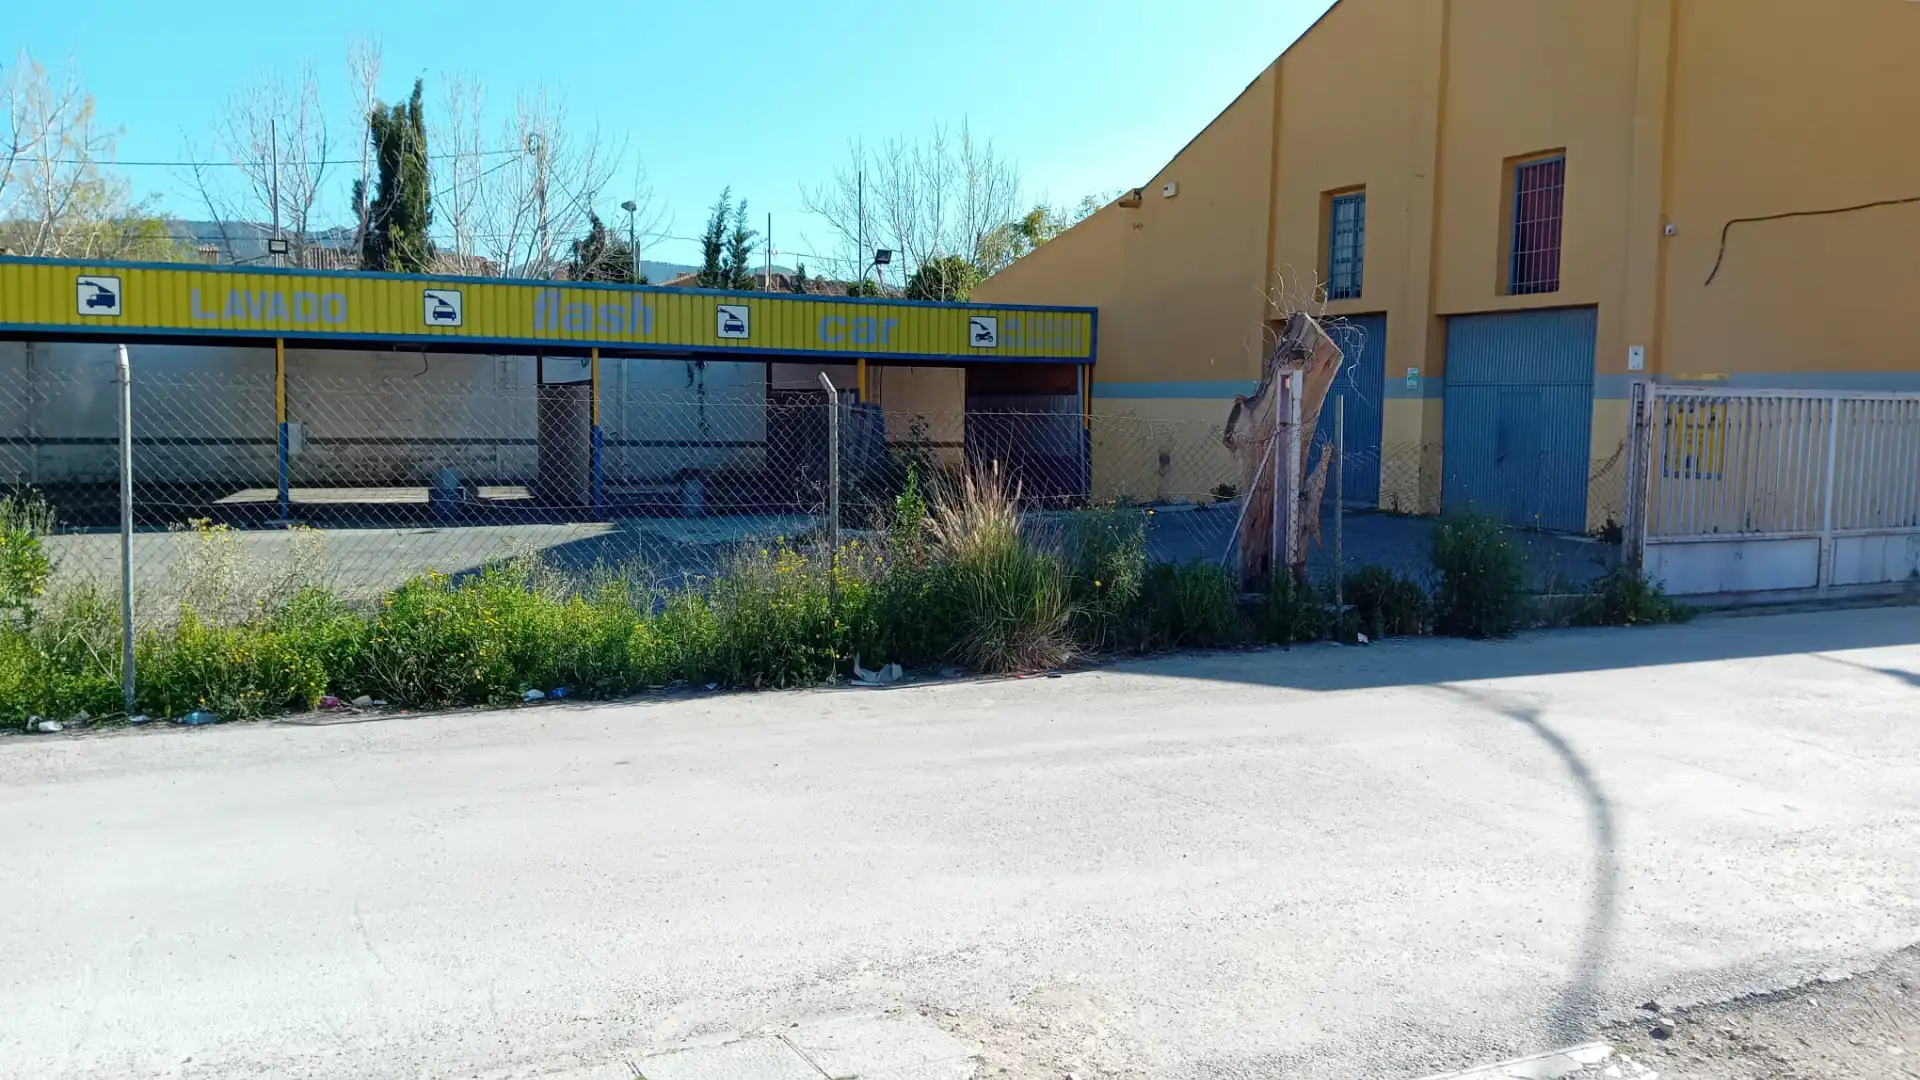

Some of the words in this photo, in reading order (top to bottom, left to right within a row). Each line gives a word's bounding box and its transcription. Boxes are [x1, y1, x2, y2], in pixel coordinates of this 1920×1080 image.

[190, 288, 348, 324] LAVADO
[533, 290, 653, 335] flash
[818, 315, 899, 345] car
